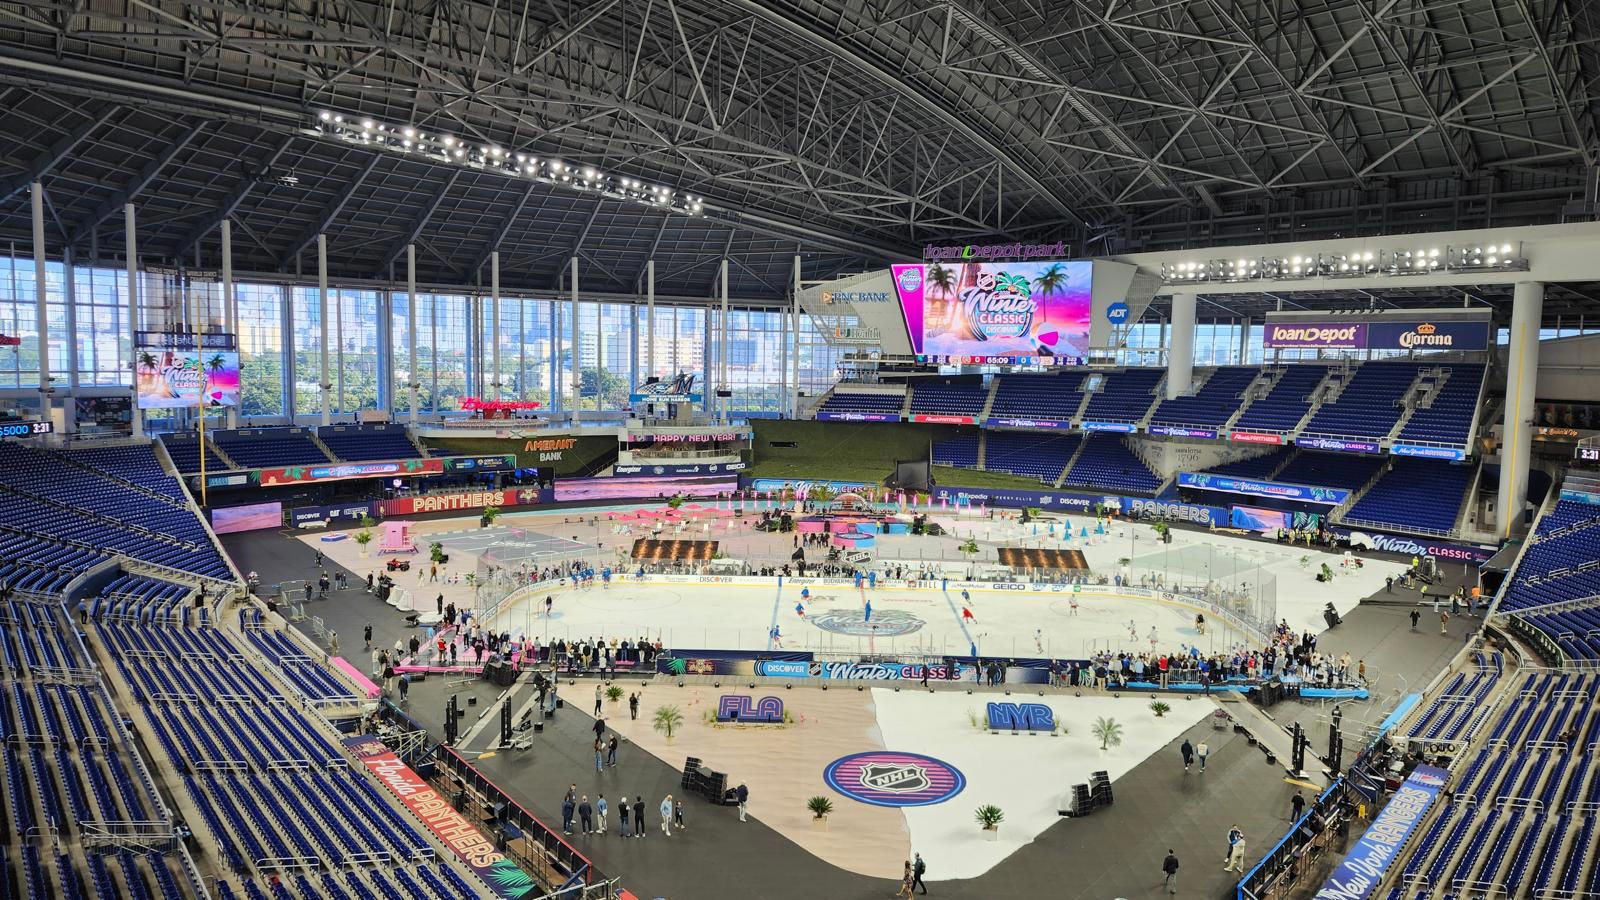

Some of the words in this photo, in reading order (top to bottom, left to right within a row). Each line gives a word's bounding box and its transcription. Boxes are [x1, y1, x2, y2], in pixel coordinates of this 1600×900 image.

[926, 242, 1022, 262] loanDepot
[1023, 239, 1066, 262] park
[834, 293, 858, 304] PNC
[859, 293, 889, 304] BANK
[960, 289, 1039, 313] Winter
[979, 313, 1026, 323] CLASSIC
[1108, 309, 1127, 319] ADT
[1272, 326, 1356, 344] loanDepot
[1399, 331, 1452, 348] Corona
[33, 422, 50, 433] 3:31
[525, 438, 576, 452] AMERANT
[653, 434, 685, 442] HAPPY
[689, 434, 709, 442] NEW
[712, 433, 736, 442] YEAR!
[540, 451, 563, 462] BANK
[1581, 449, 1598, 460] 3:31
[616, 466, 642, 474] Energizer
[726, 463, 746, 471] GEICO
[413, 491, 505, 513] PANTHERS
[1060, 498, 1090, 506] DISCOVER
[296, 512, 321, 520] DISCOVER
[1132, 499, 1210, 523] RANGERS
[1370, 534, 1428, 557] Winter
[1428, 546, 1472, 560] CLASSIC
[789, 577, 816, 585] Energizer
[767, 662, 804, 671] DISCOVER
[826, 662, 898, 680] Winter
[901, 666, 961, 680] CLSSC
[718, 694, 784, 723] FLA
[986, 702, 1056, 732] NYR
[876, 770, 915, 787] NHL
[364, 757, 427, 796] Florida
[406, 789, 505, 869] PANTHERS
[1365, 786, 1432, 847] RANGERS
[1343, 840, 1393, 877] York
[1328, 878, 1371, 900] New
